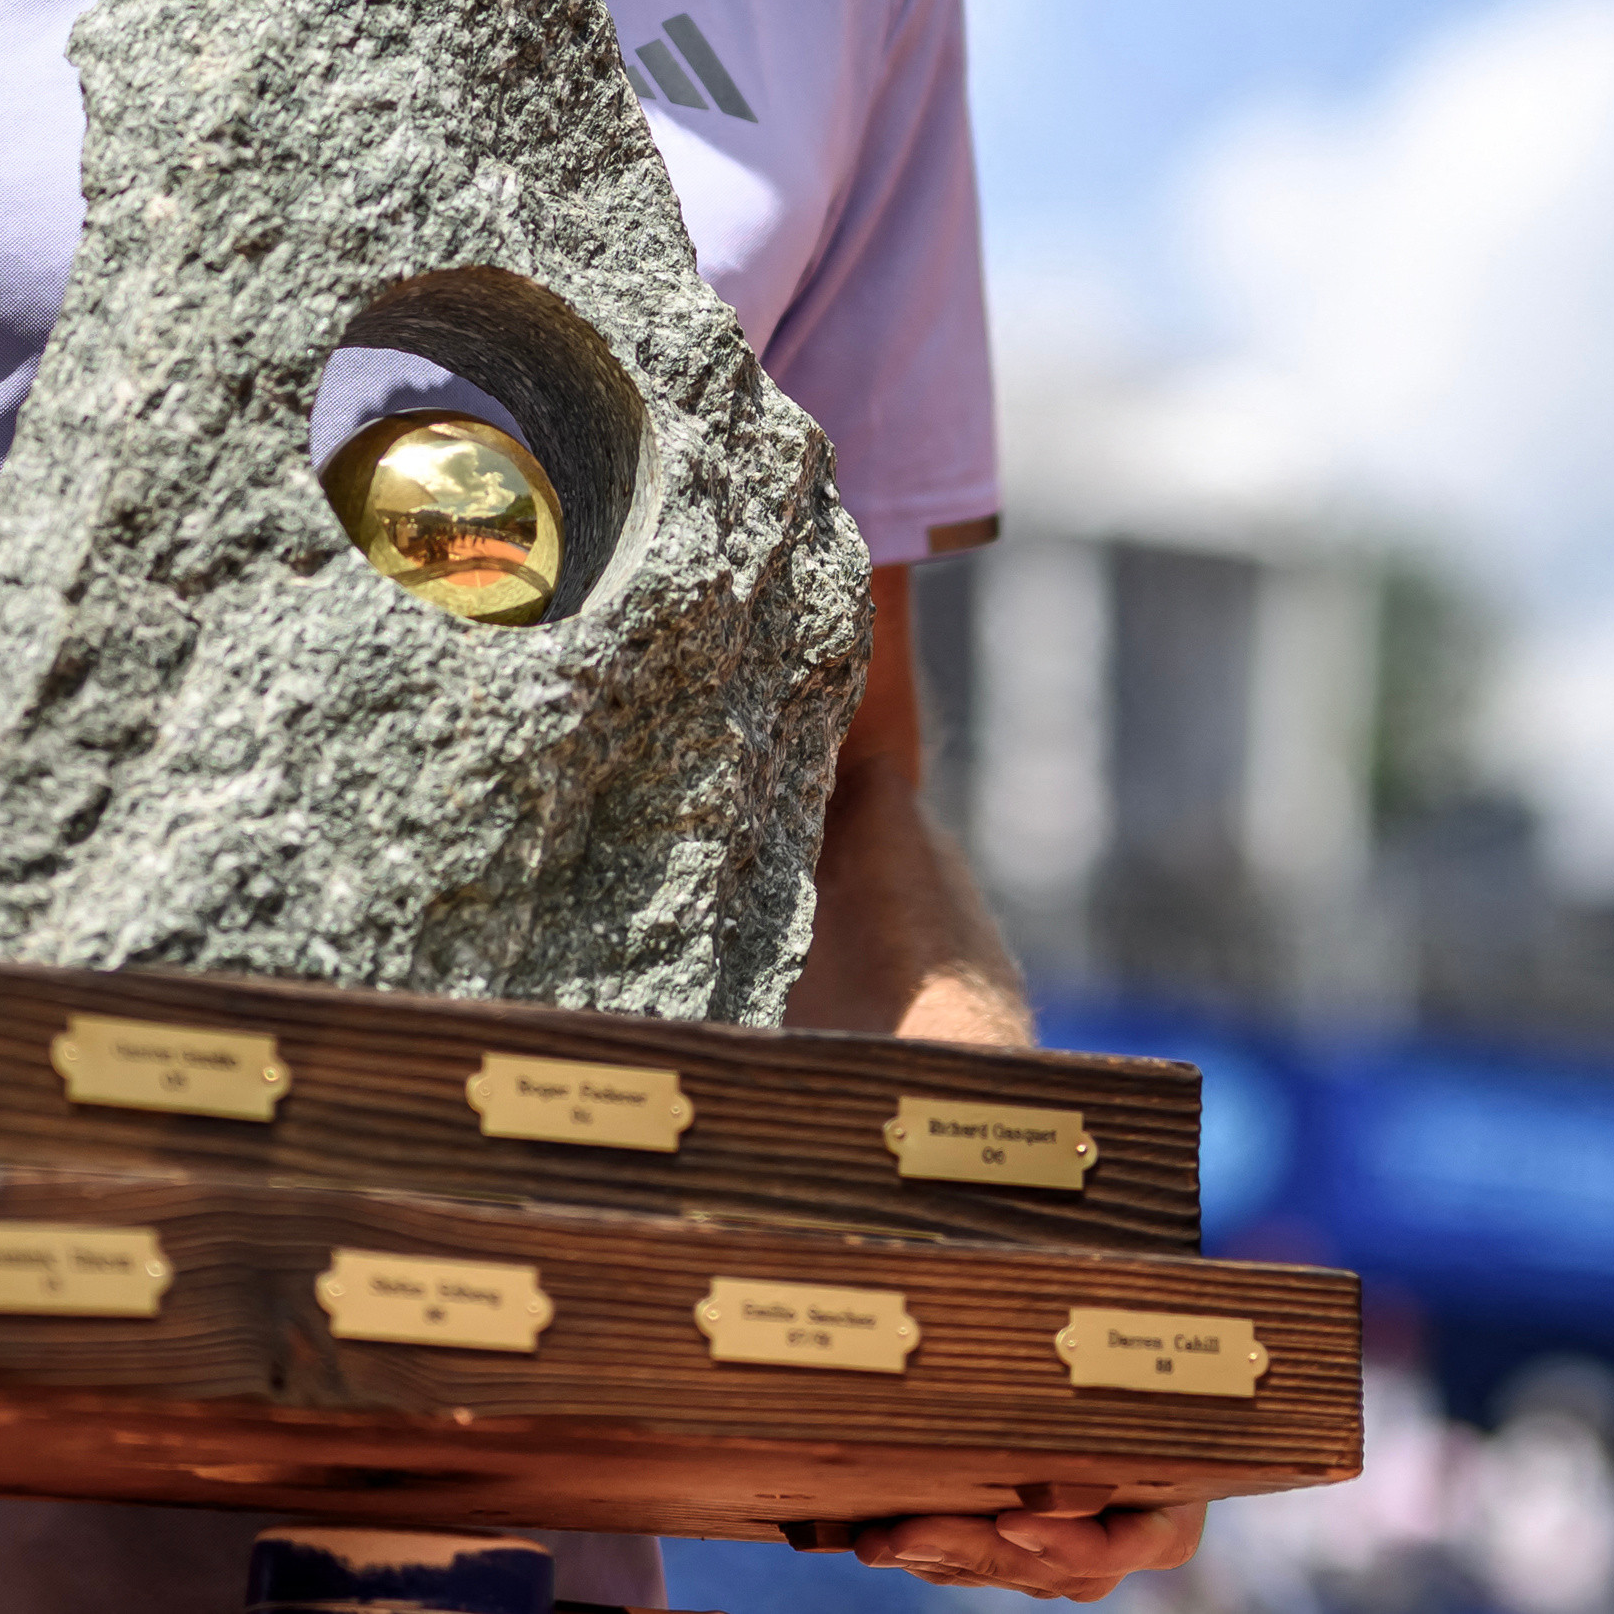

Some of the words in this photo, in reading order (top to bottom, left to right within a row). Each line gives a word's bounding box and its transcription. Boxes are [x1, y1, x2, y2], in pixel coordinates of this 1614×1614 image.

[929, 1118, 988, 1138] Richard
[993, 1122, 1057, 1146] Gasquet
[1108, 1329, 1163, 1350] Darren
[1174, 1334, 1221, 1354] Cahill
